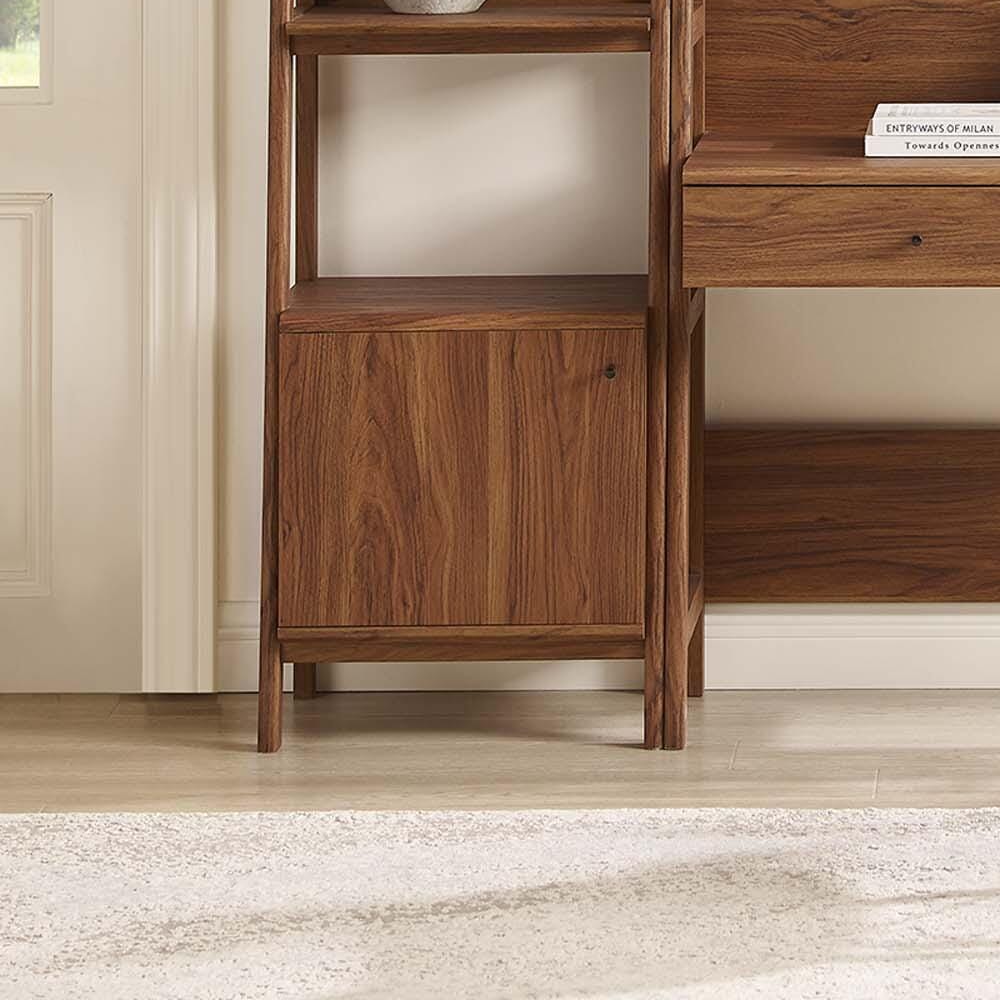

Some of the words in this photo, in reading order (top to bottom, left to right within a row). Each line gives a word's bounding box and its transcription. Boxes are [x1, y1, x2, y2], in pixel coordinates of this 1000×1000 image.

[886, 124, 945, 134] ENTRYWAYS
[946, 124, 961, 134] OF
[962, 124, 994, 134] MILAN
[905, 141, 950, 151] Towards
